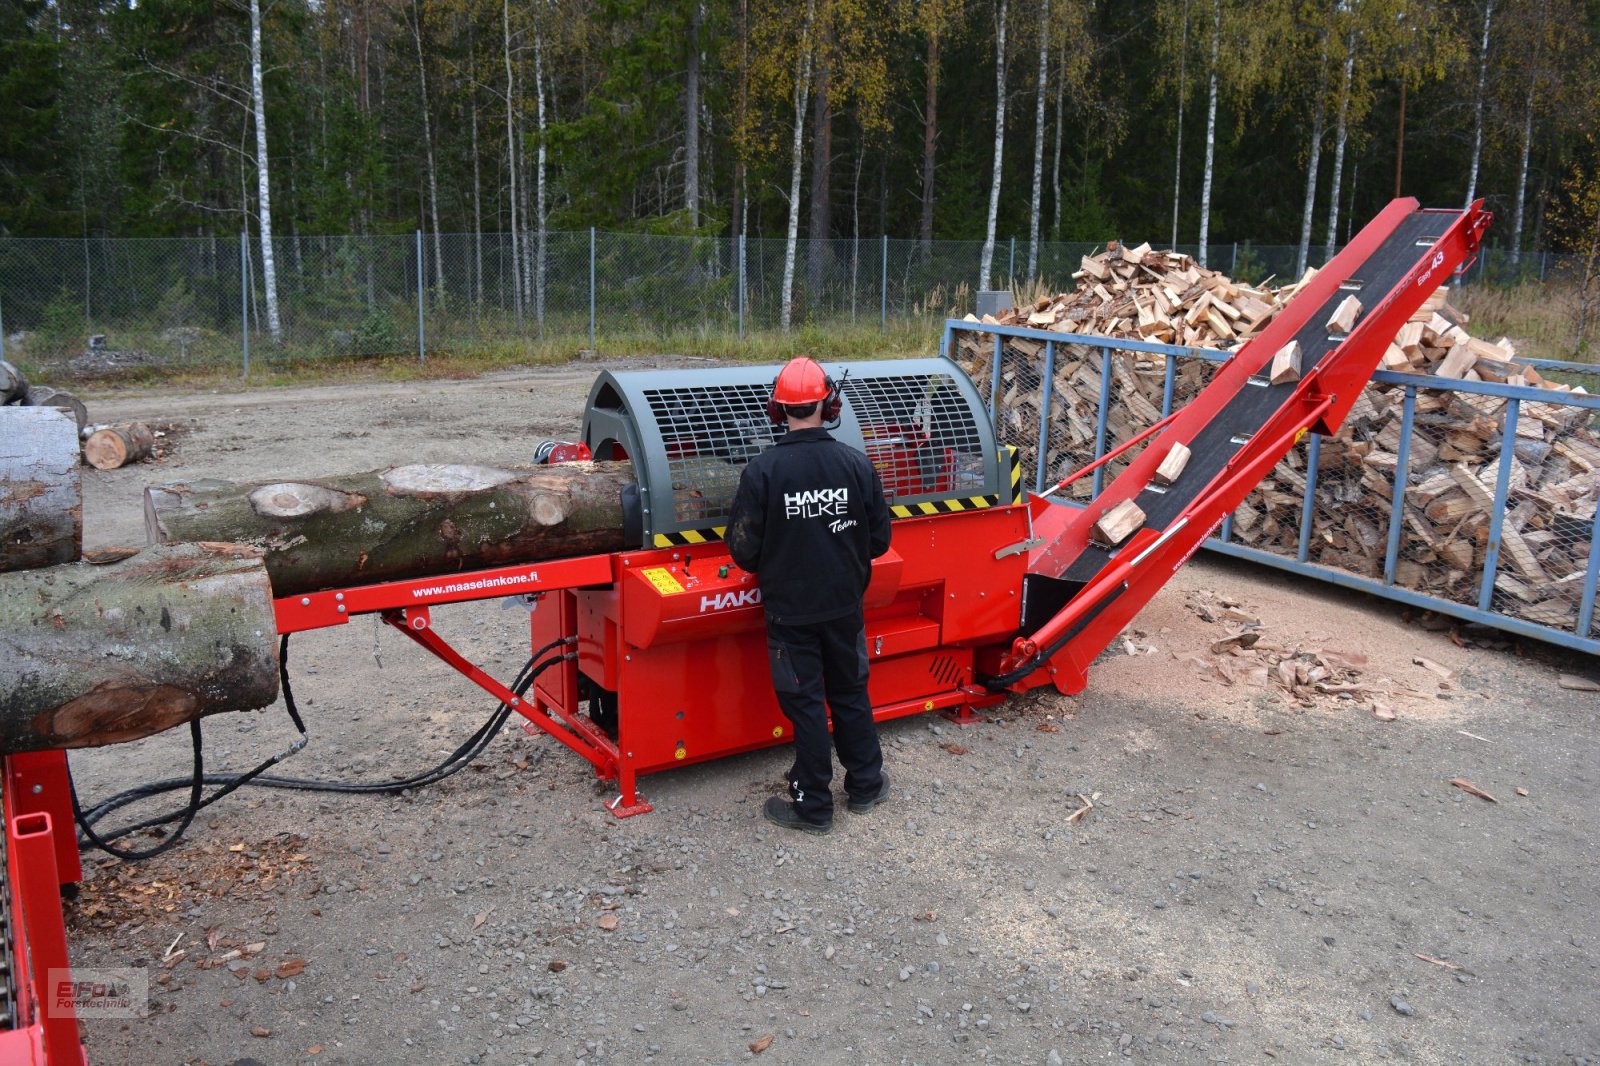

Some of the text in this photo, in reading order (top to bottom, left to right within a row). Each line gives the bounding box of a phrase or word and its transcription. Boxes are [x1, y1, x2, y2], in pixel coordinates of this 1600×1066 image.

[1417, 251, 1444, 286] Easy 43
[784, 488, 848, 506] HAKKI
[785, 501, 848, 519] PILKE
[828, 519, 858, 533] Team
[413, 571, 538, 597] www.maaselankone.fi
